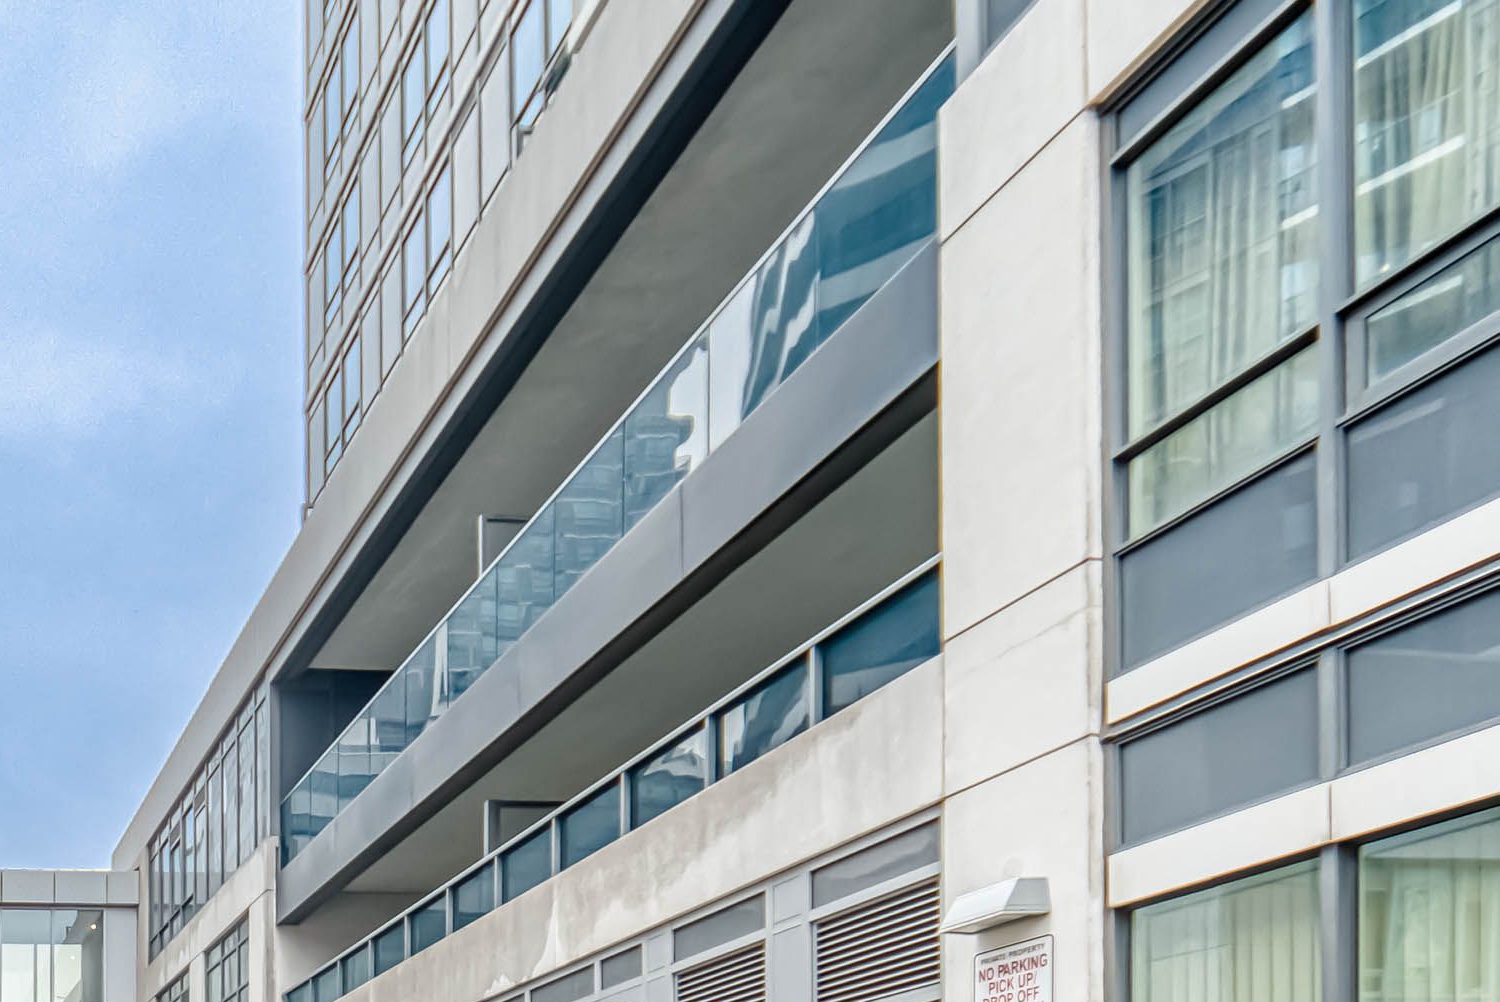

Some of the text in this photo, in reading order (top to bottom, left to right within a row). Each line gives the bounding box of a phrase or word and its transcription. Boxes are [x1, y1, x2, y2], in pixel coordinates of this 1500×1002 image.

[979, 953, 1048, 983] NO PARKING
[989, 977, 1014, 995] PICK
[1017, 986, 1040, 1002] OFF
